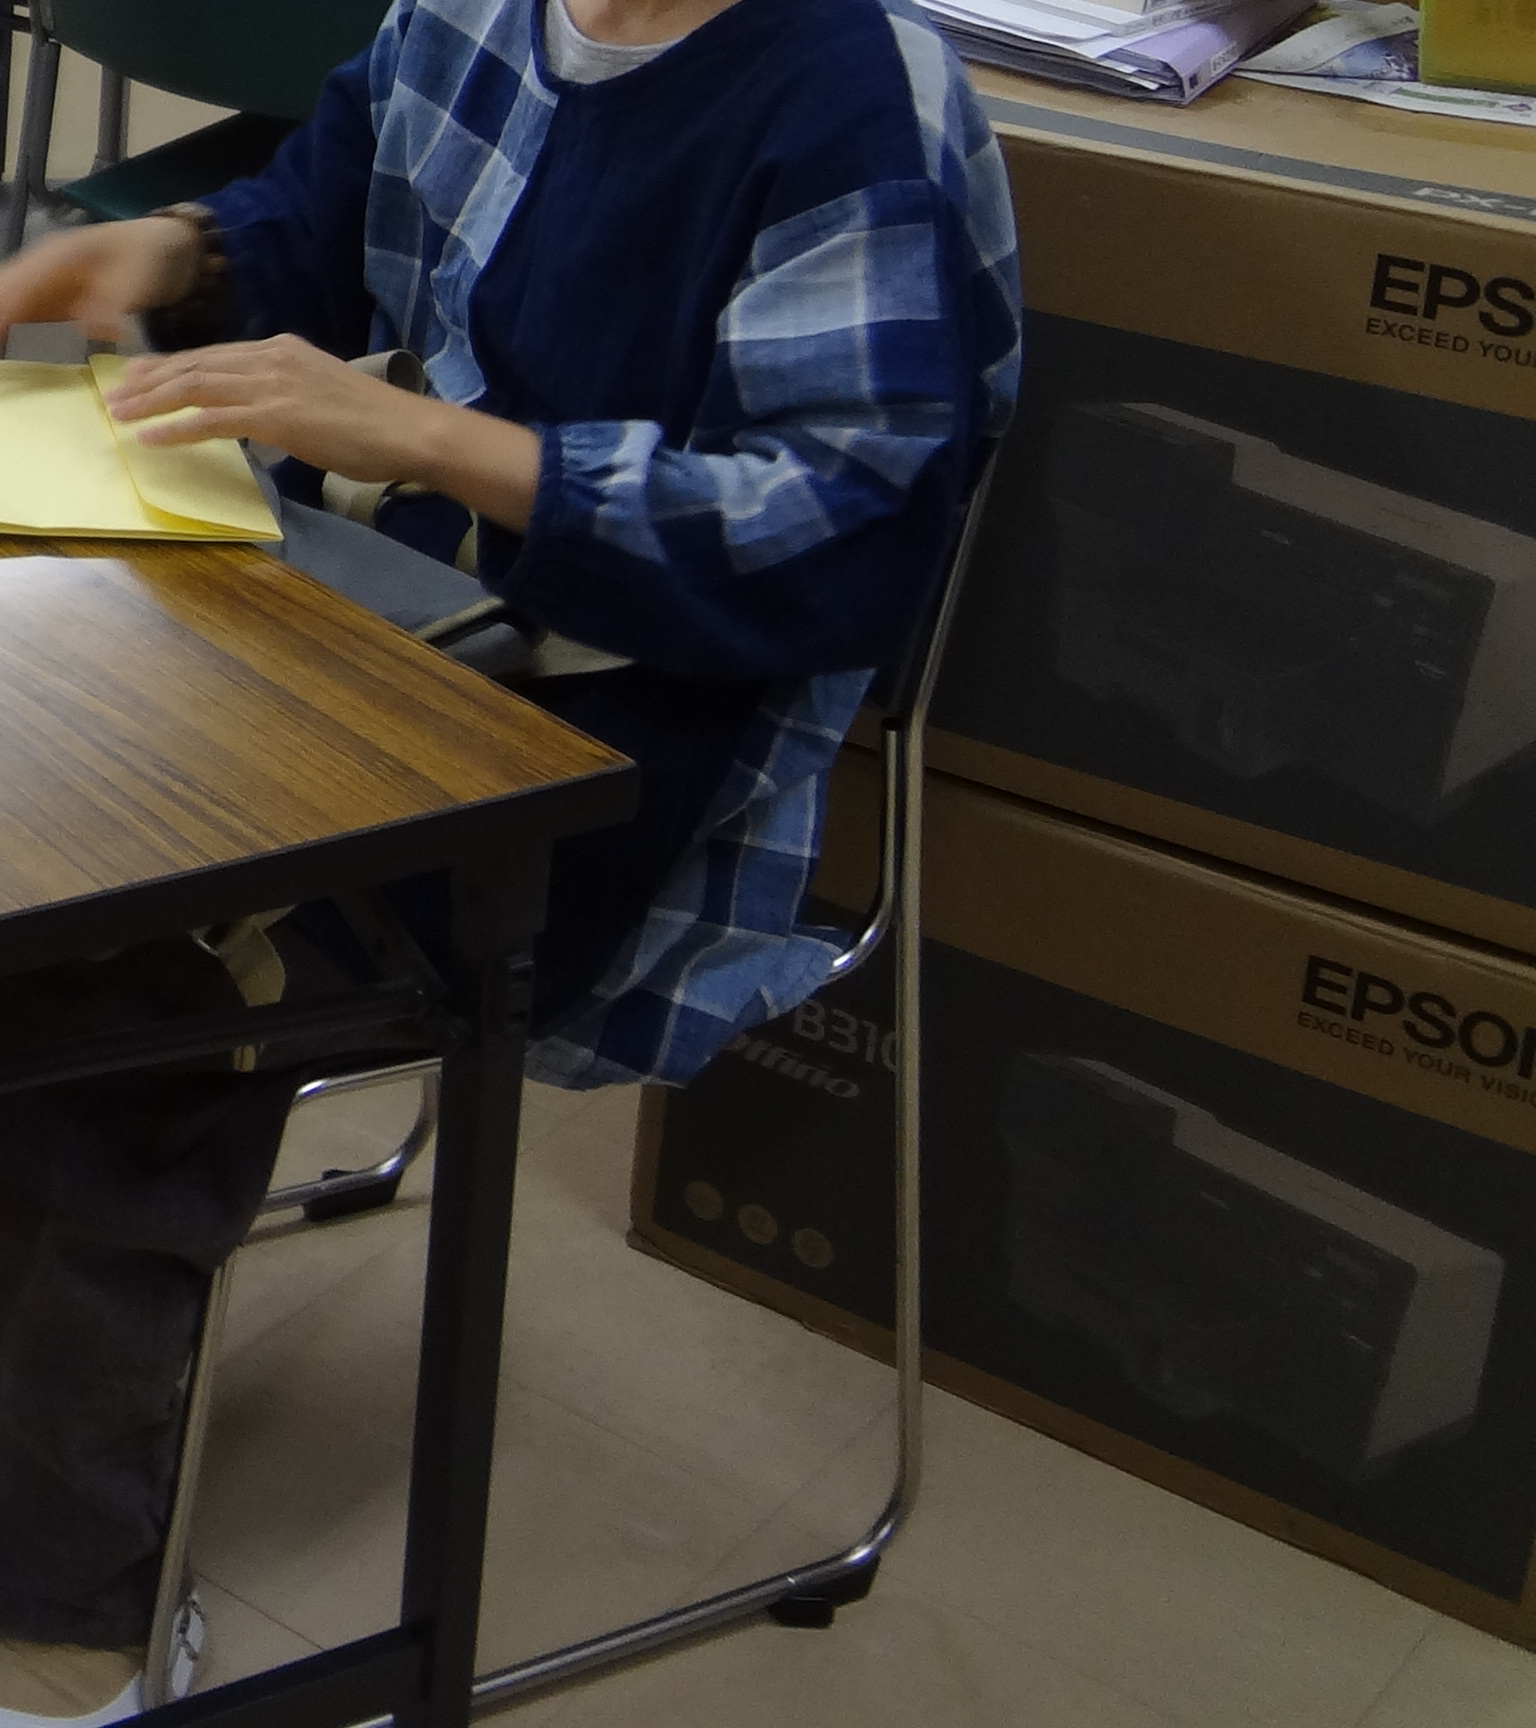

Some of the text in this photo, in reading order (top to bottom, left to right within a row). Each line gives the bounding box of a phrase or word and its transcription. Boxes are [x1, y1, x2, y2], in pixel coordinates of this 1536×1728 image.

[1365, 317, 1536, 369] EXCEED YOU
[1296, 1011, 1395, 1056] EXCEED
[1403, 1046, 1471, 1084] YOUR
